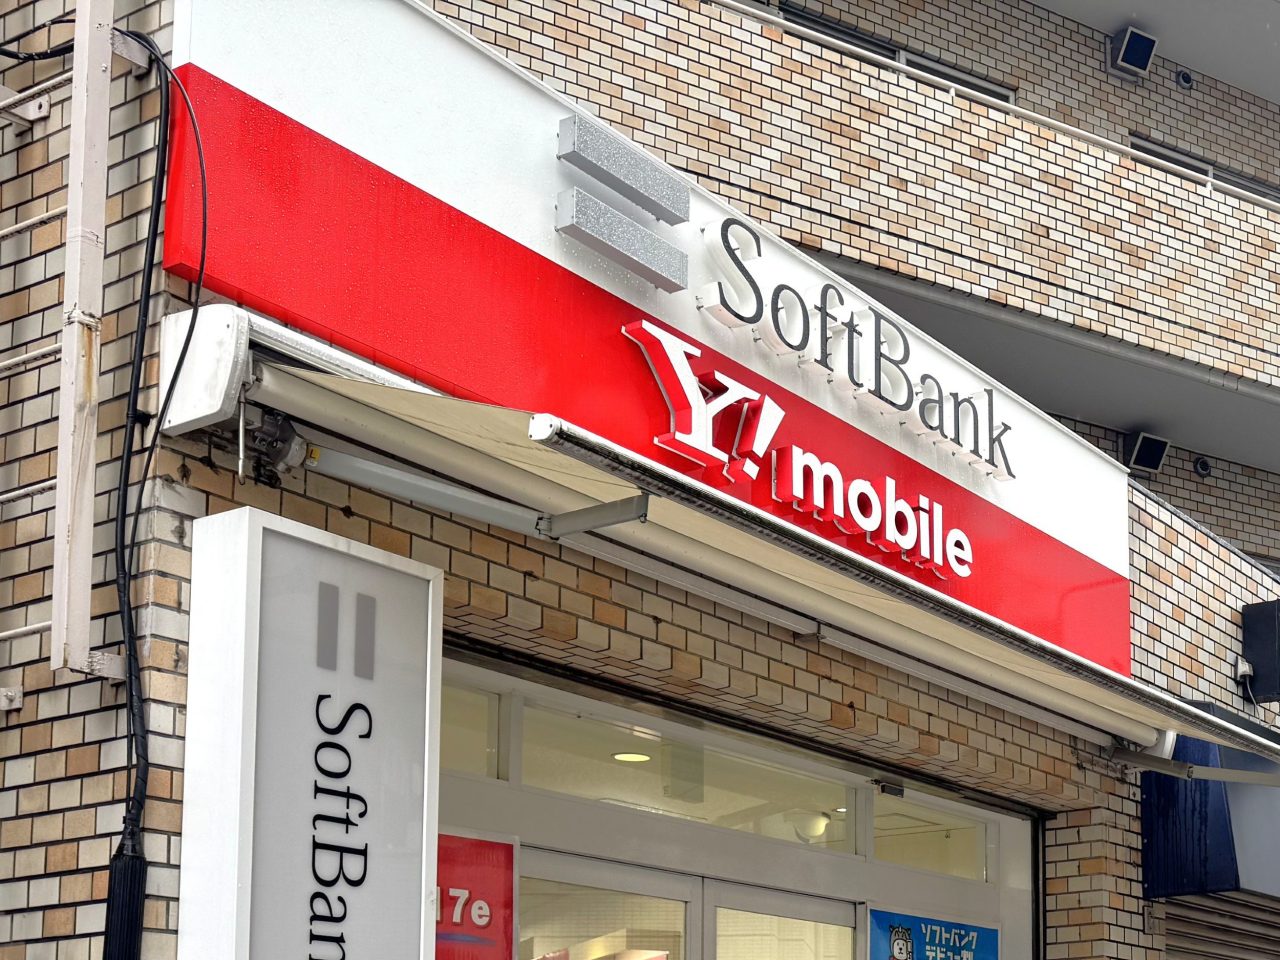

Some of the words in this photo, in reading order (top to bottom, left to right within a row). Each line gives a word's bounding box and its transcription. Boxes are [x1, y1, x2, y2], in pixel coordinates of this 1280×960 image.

[716, 217, 1017, 479] SoftBank
[921, 922, 978, 950] ソフトバンク
